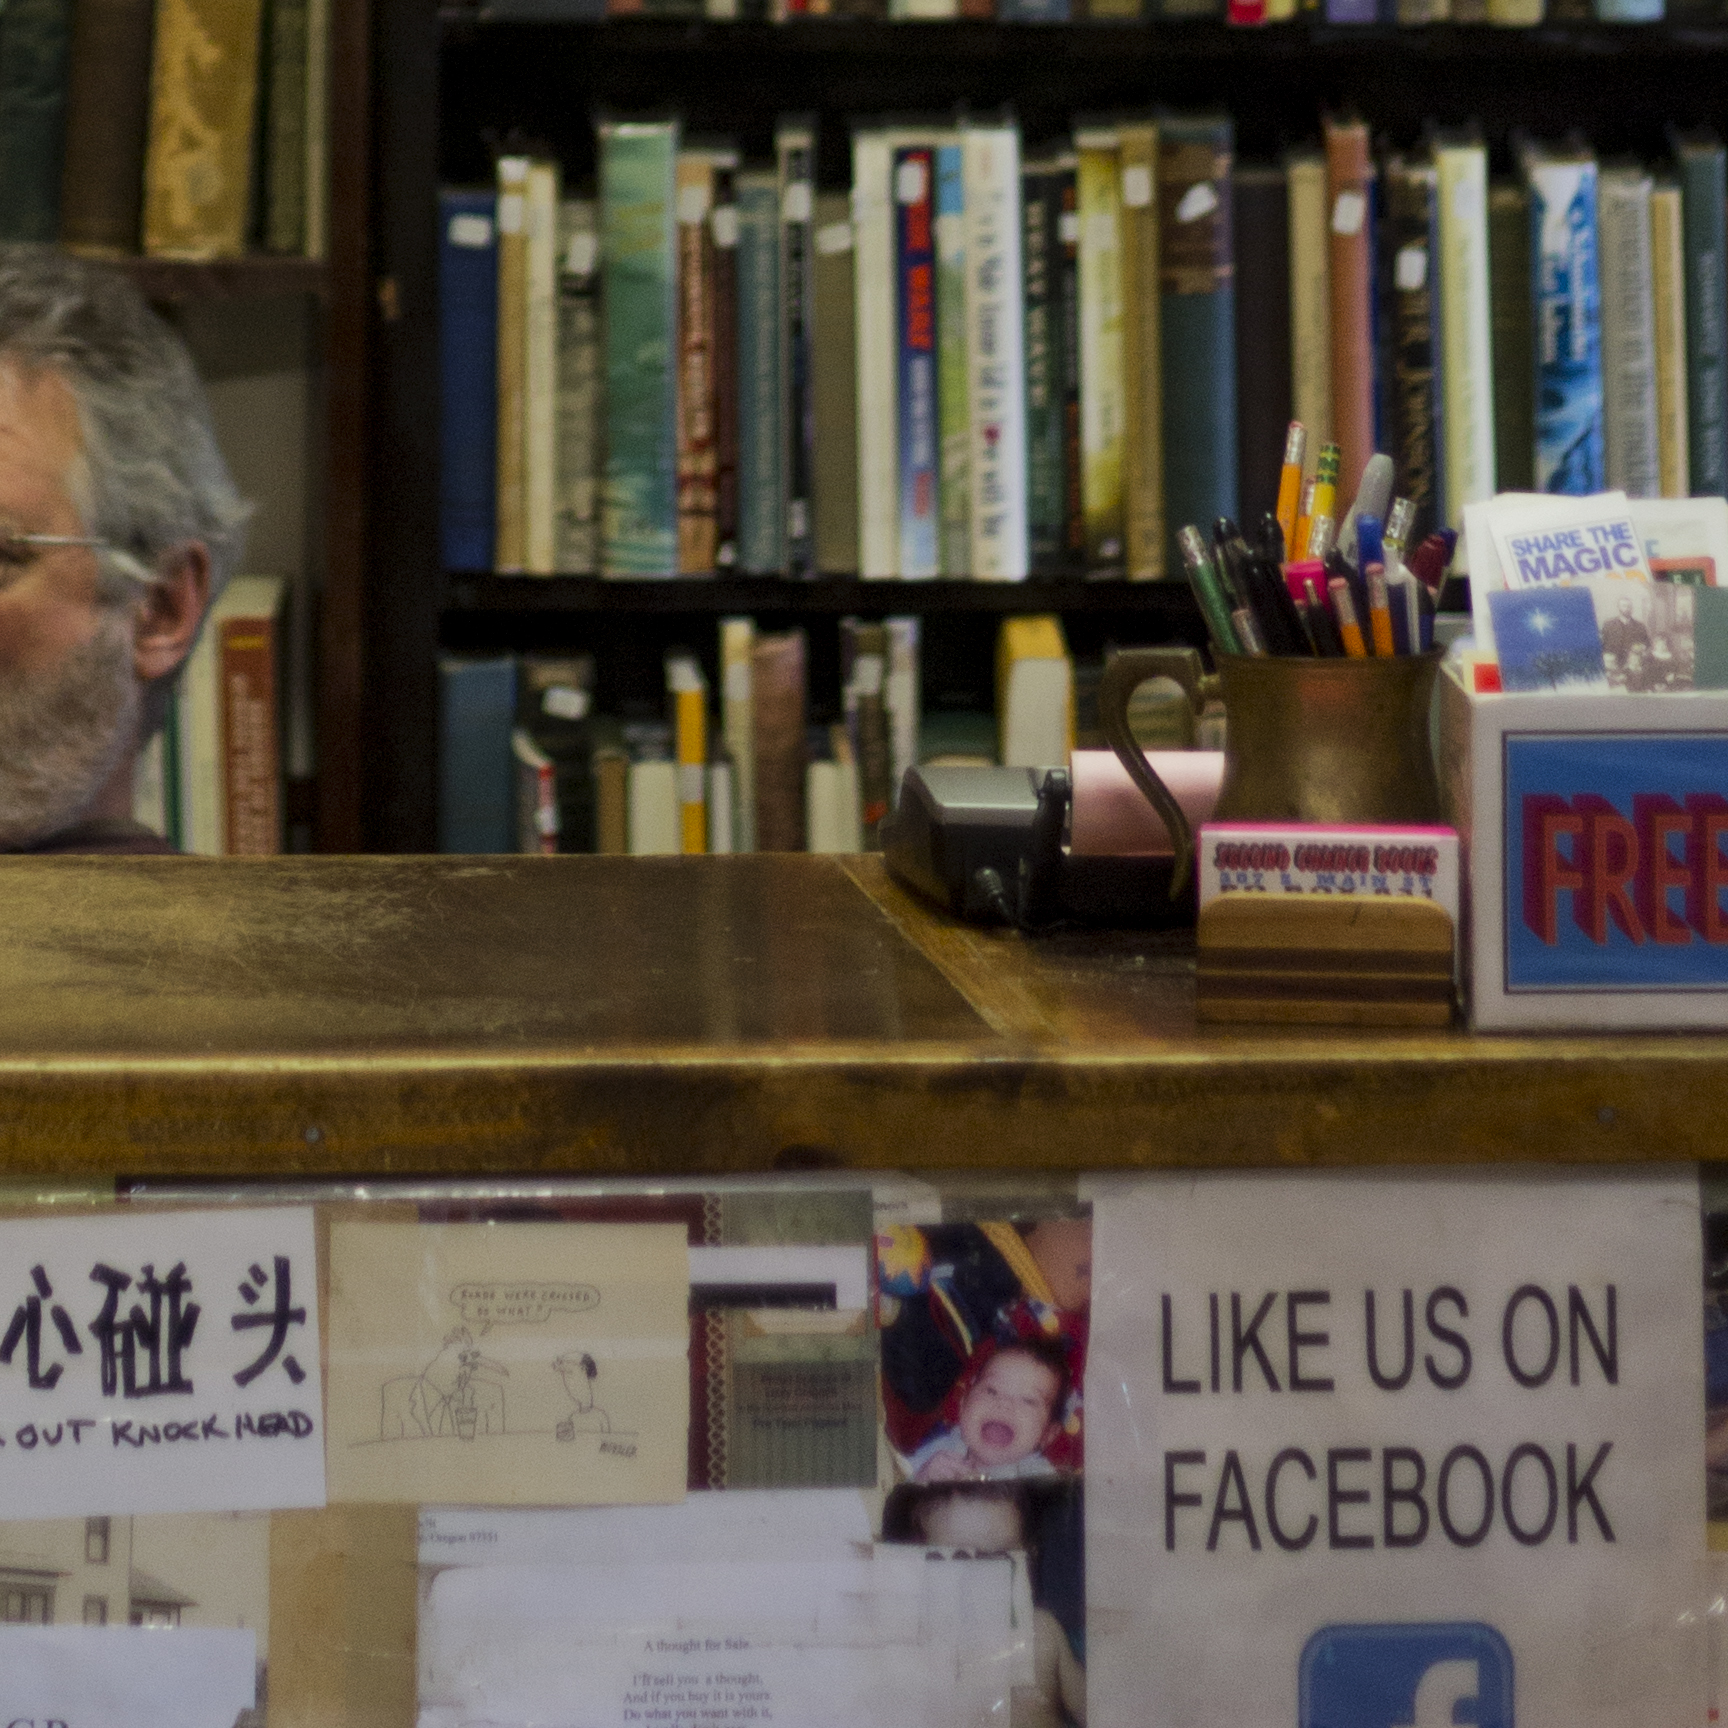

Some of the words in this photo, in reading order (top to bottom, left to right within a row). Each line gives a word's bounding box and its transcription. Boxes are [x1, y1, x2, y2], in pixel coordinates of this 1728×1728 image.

[1511, 528, 1583, 558] SHARE
[1587, 522, 1634, 545] THE
[1517, 544, 1640, 585] MAGIC
[1316, 873, 1387, 889] MAIN
[1522, 792, 1728, 946] FREE
[1160, 1289, 1336, 1395] LIKE
[1364, 1284, 1474, 1392] US
[1500, 1281, 1621, 1389] ON
[15, 1418, 97, 1450] OUT
[111, 1413, 230, 1450] KNOCK
[235, 1410, 314, 1441] HEAD
[1163, 1441, 1617, 1554] FACEBOOK
[656, 1638, 700, 1655] thought
[704, 1638, 721, 1652] for
[623, 1690, 648, 1704] And
[663, 1693, 686, 1706] you
[688, 1691, 709, 1706] buy
[677, 1676, 699, 1689] you
[623, 1708, 641, 1721] Do
[644, 1707, 672, 1720] what
[675, 1709, 697, 1724] you
[699, 1709, 728, 1720] want
[732, 1706, 758, 1720] with
